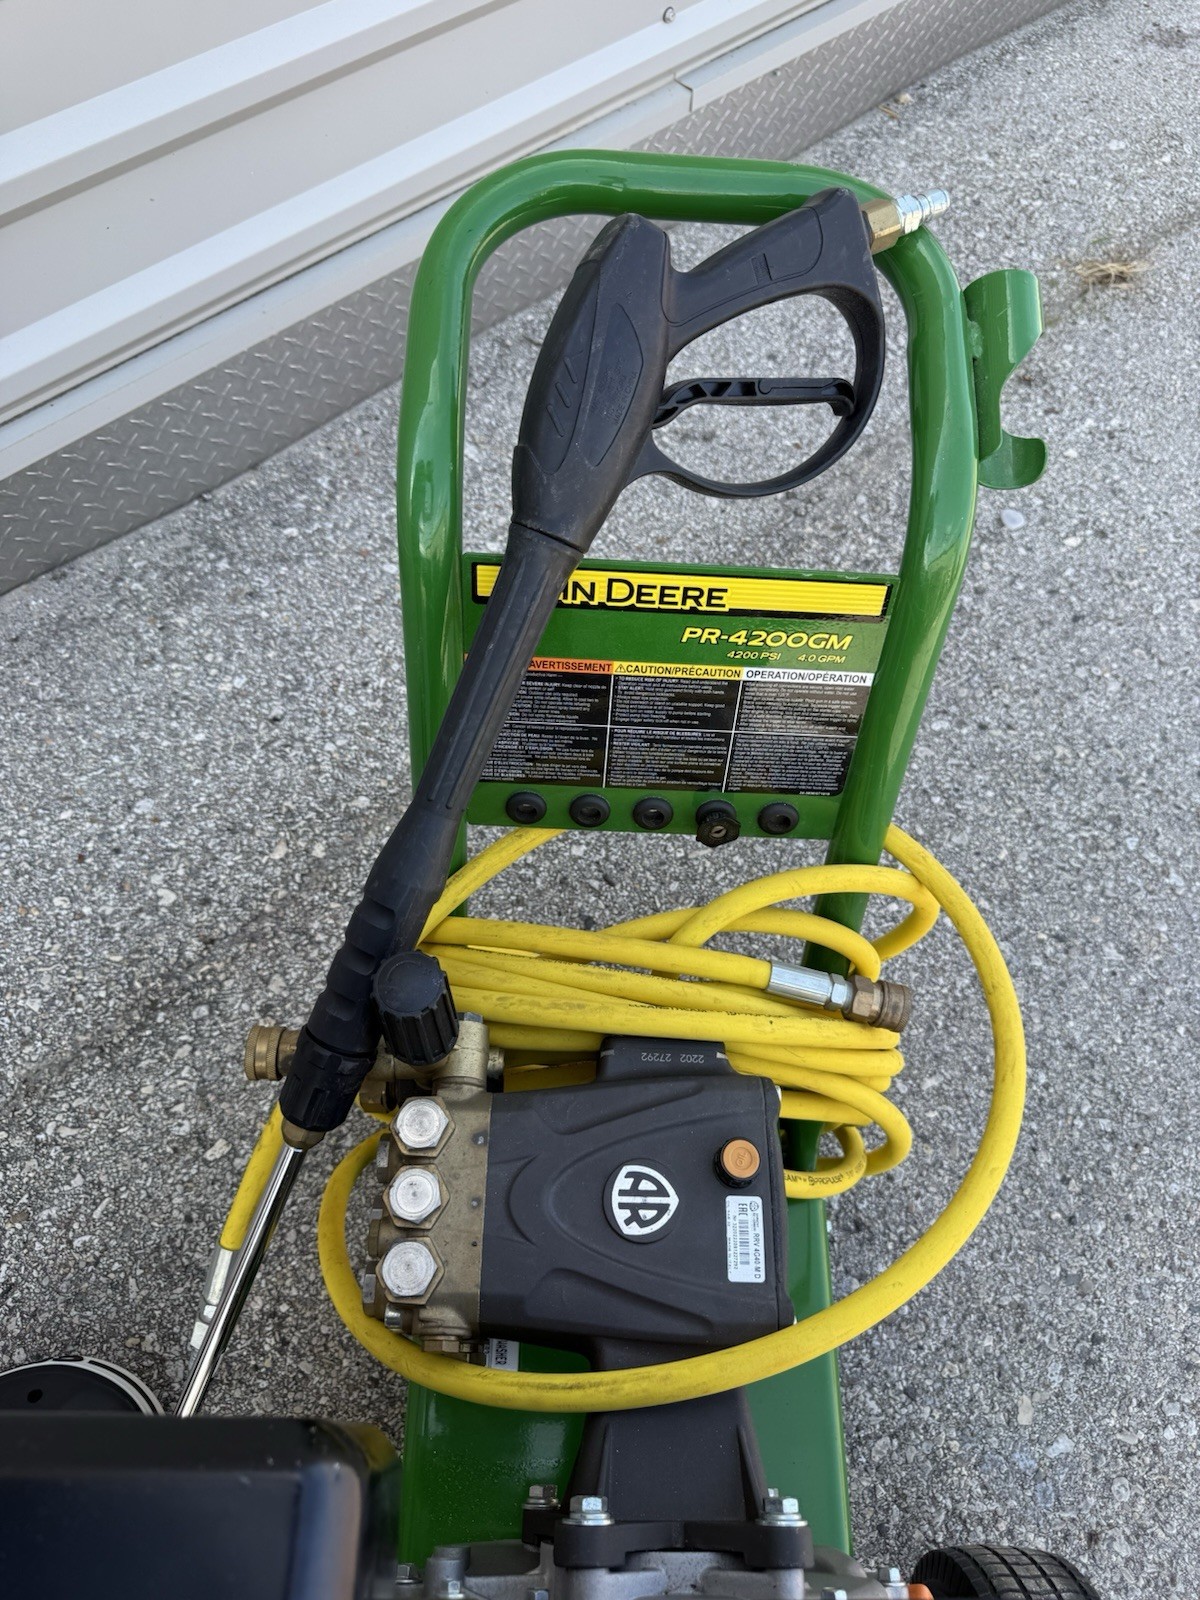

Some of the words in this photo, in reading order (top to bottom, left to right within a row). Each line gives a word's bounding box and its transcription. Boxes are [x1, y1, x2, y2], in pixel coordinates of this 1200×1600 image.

[606, 578, 728, 608] DEERE
[681, 626, 854, 651] PR-4200GM
[727, 650, 758, 660] 4200
[760, 652, 782, 661] PSI
[797, 653, 816, 663] 4.0
[817, 655, 847, 664] GPM
[529, 660, 613, 673] AVERTISSEMENT
[626, 664, 741, 679] CAUTION/PRÉCAUTION
[746, 669, 868, 685] OPERATION/OPÉRATION
[641, 1052, 672, 1062] 27292
[680, 1053, 705, 1064] 2202
[617, 1170, 671, 1229] AR
